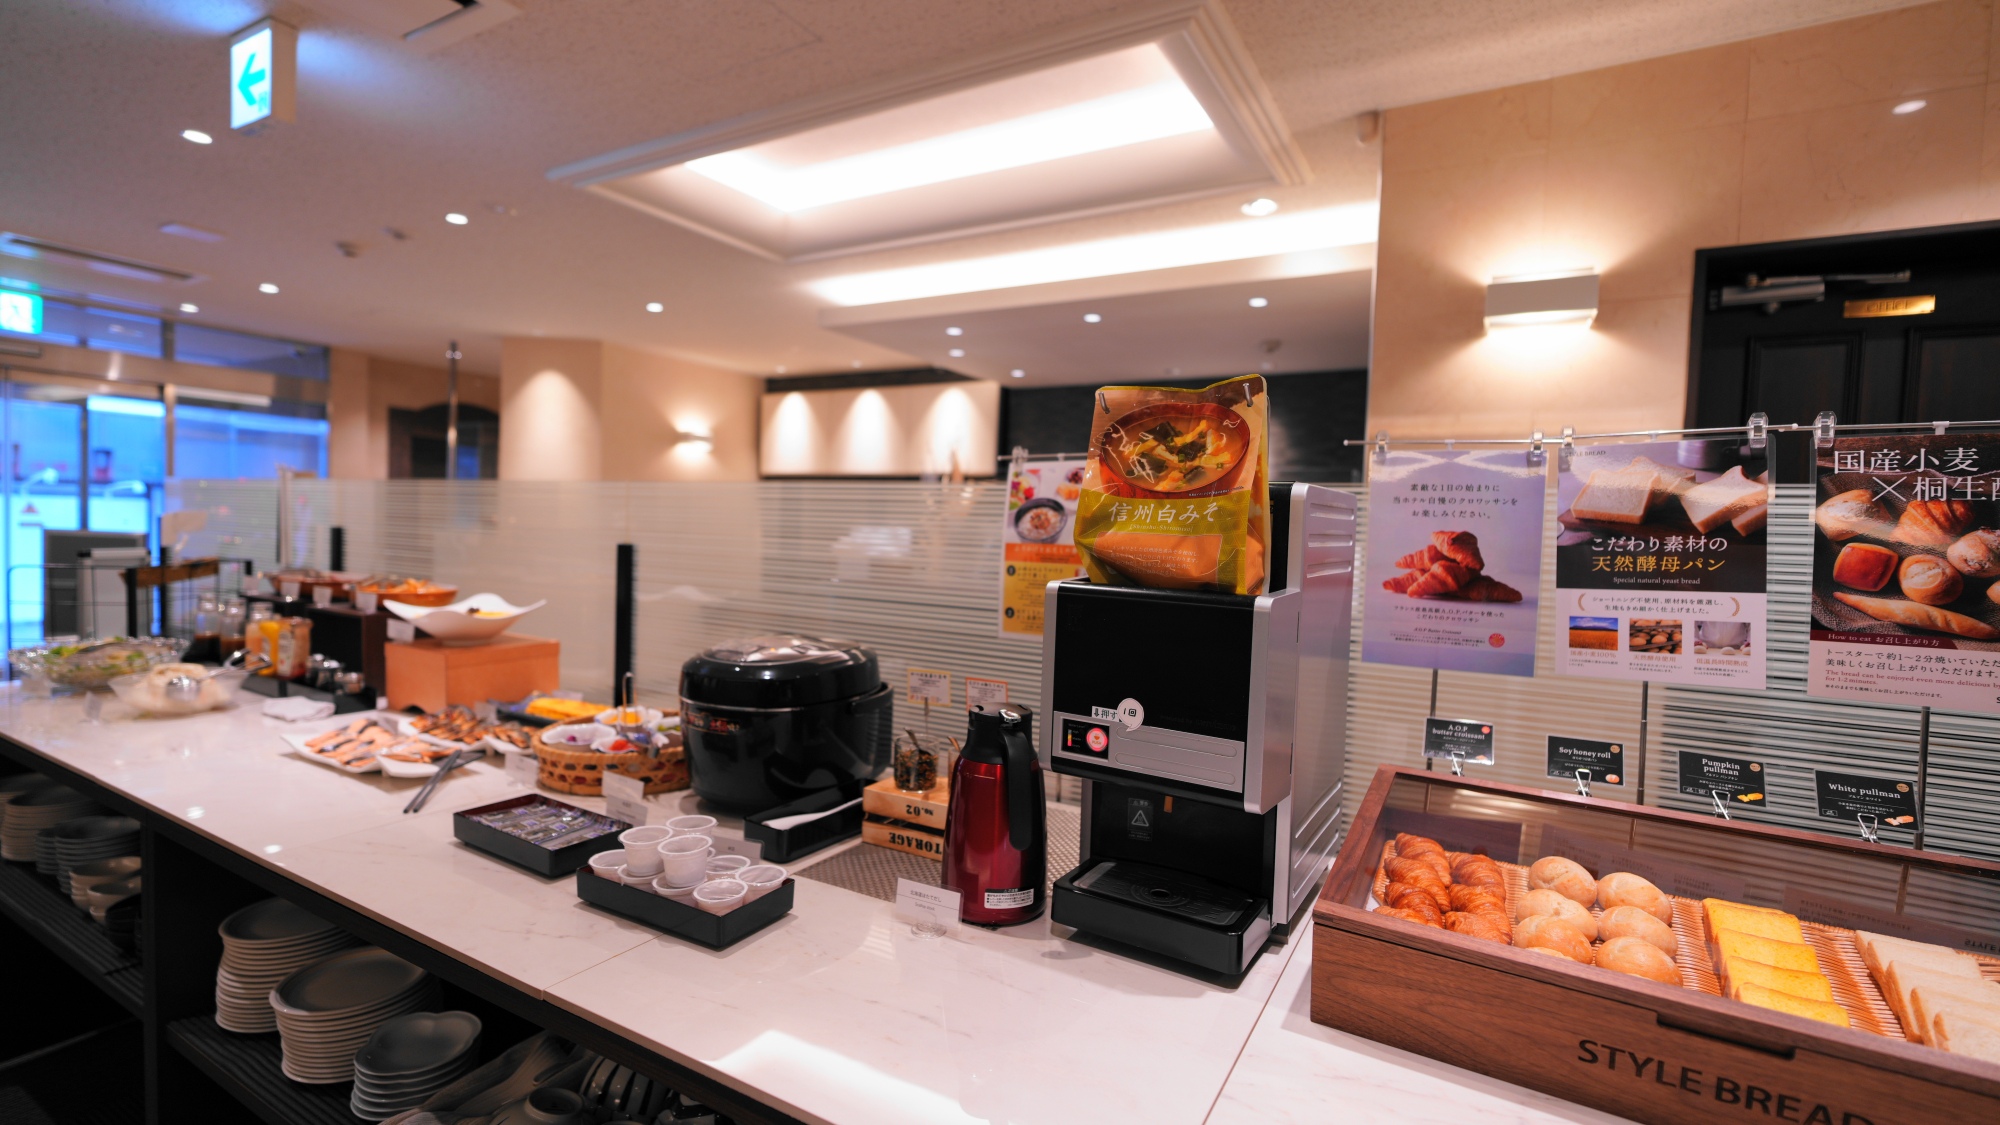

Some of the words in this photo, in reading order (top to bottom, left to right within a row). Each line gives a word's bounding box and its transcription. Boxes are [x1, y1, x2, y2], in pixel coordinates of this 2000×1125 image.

[1834, 447, 1980, 475] 国産小麦
[1410, 483, 1500, 493] 素敵な1日の始まりに
[1872, 476, 2000, 502] ×桐生
[1392, 496, 1518, 507] 当ホテル自慢のクロワッサンを
[1109, 501, 1219, 524] 信州白みそ
[1411, 509, 1491, 519] お楽しみください。
[1591, 535, 1728, 552] こだわり素材の
[1592, 555, 1726, 573] 天然酵母パン
[1613, 576, 1636, 585] Special
[1637, 576, 1661, 584] natural
[1662, 578, 1680, 586] yeast
[1681, 577, 1700, 585] bread
[1604, 604, 1710, 615] 生地もきめ細かく仕上げました。
[1876, 636, 1940, 647] お召し上がり方
[1825, 658, 1999, 679] 美味しくお召し上がりいただけます。
[1841, 670, 1860, 678] bread
[1887, 674, 1914, 682] enjoyed
[1957, 679, 1991, 688] delicious
[1101, 709, 1117, 720] 押す
[1432, 728, 1453, 736] butter
[1454, 731, 1485, 740] croissant
[1559, 746, 1573, 755] Soy
[1573, 748, 1597, 758] honey
[1702, 758, 1740, 770] Pumpkin
[1703, 766, 1739, 776] pullman
[1828, 783, 1857, 793] White
[1859, 788, 1901, 799] pullman
[1577, 1039, 1702, 1095] STYLE
